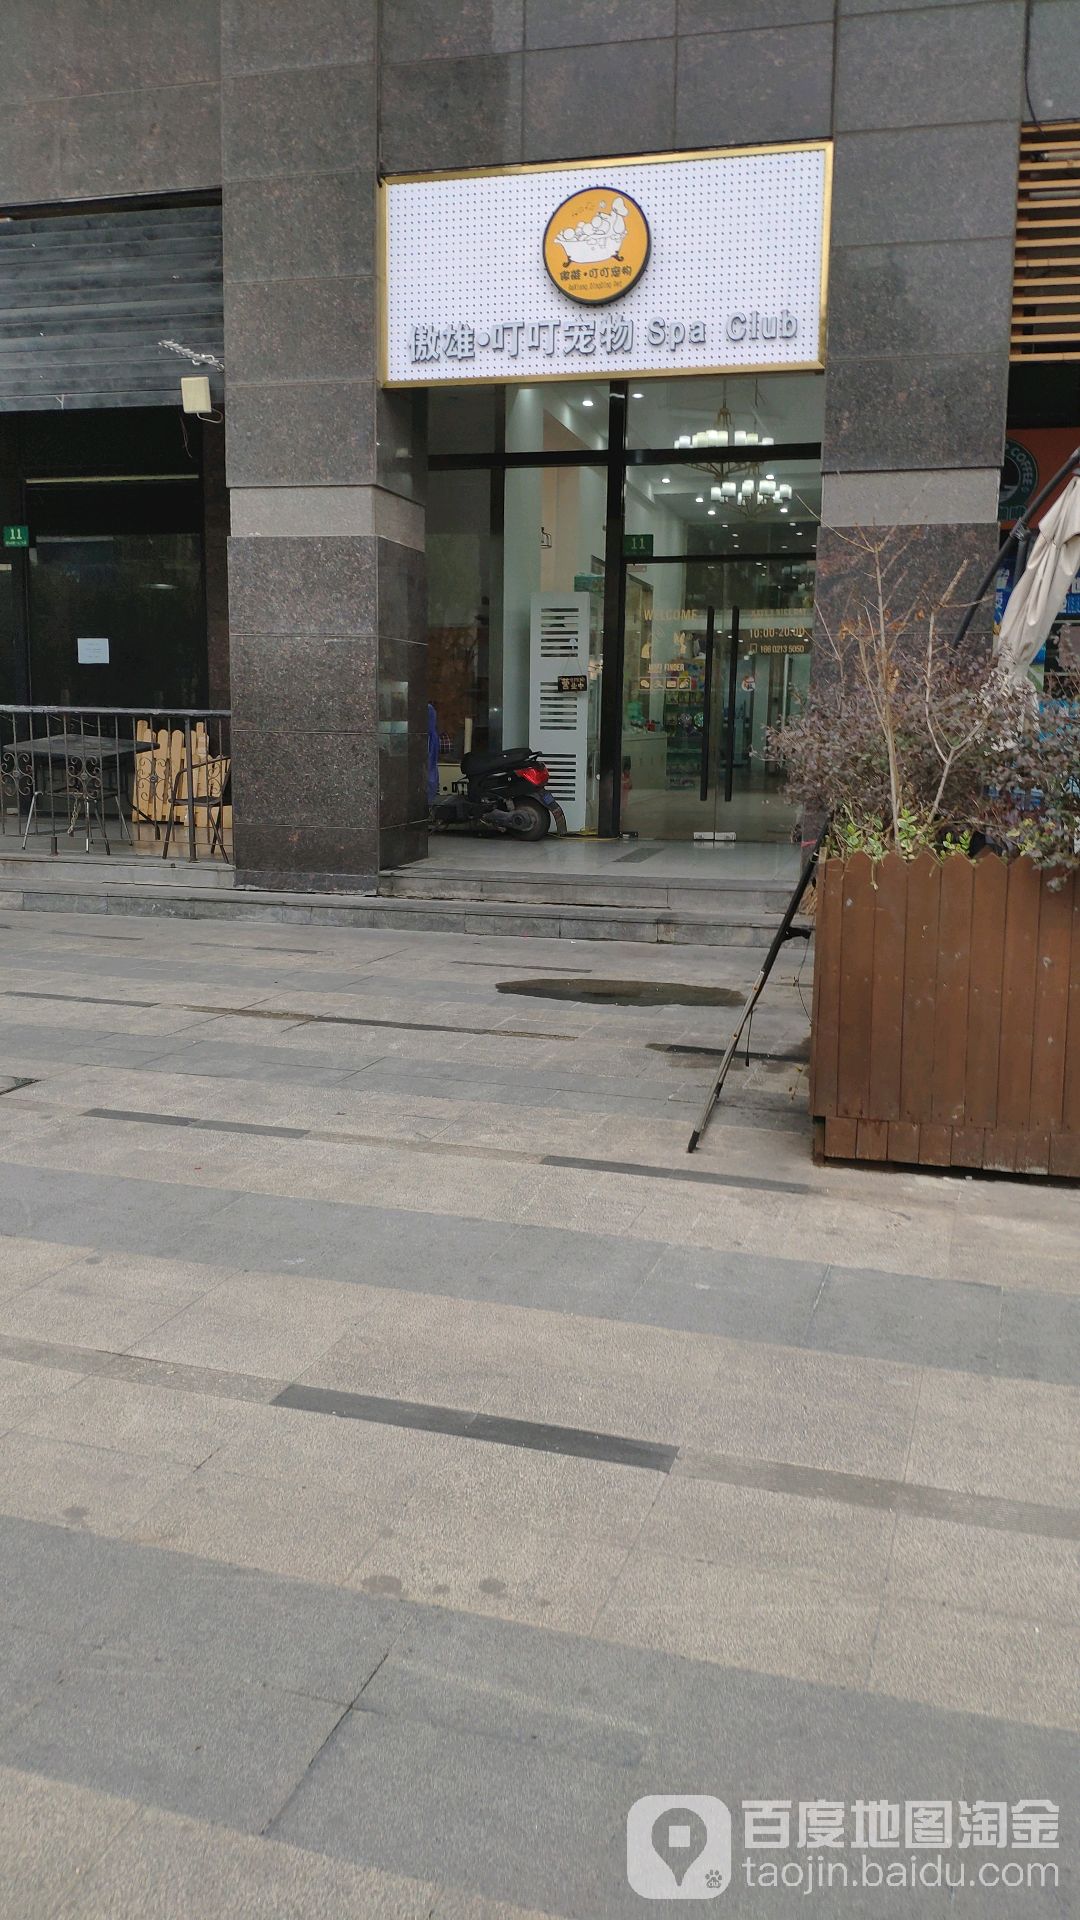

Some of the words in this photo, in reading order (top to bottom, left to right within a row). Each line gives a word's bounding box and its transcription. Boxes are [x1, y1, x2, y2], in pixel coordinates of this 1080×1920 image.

[648, 316, 707, 351] Spa
[726, 309, 798, 341] Club
[1010, 448, 1033, 484] COFFEE
[10, 528, 22, 539] 11
[631, 536, 645, 549] 11
